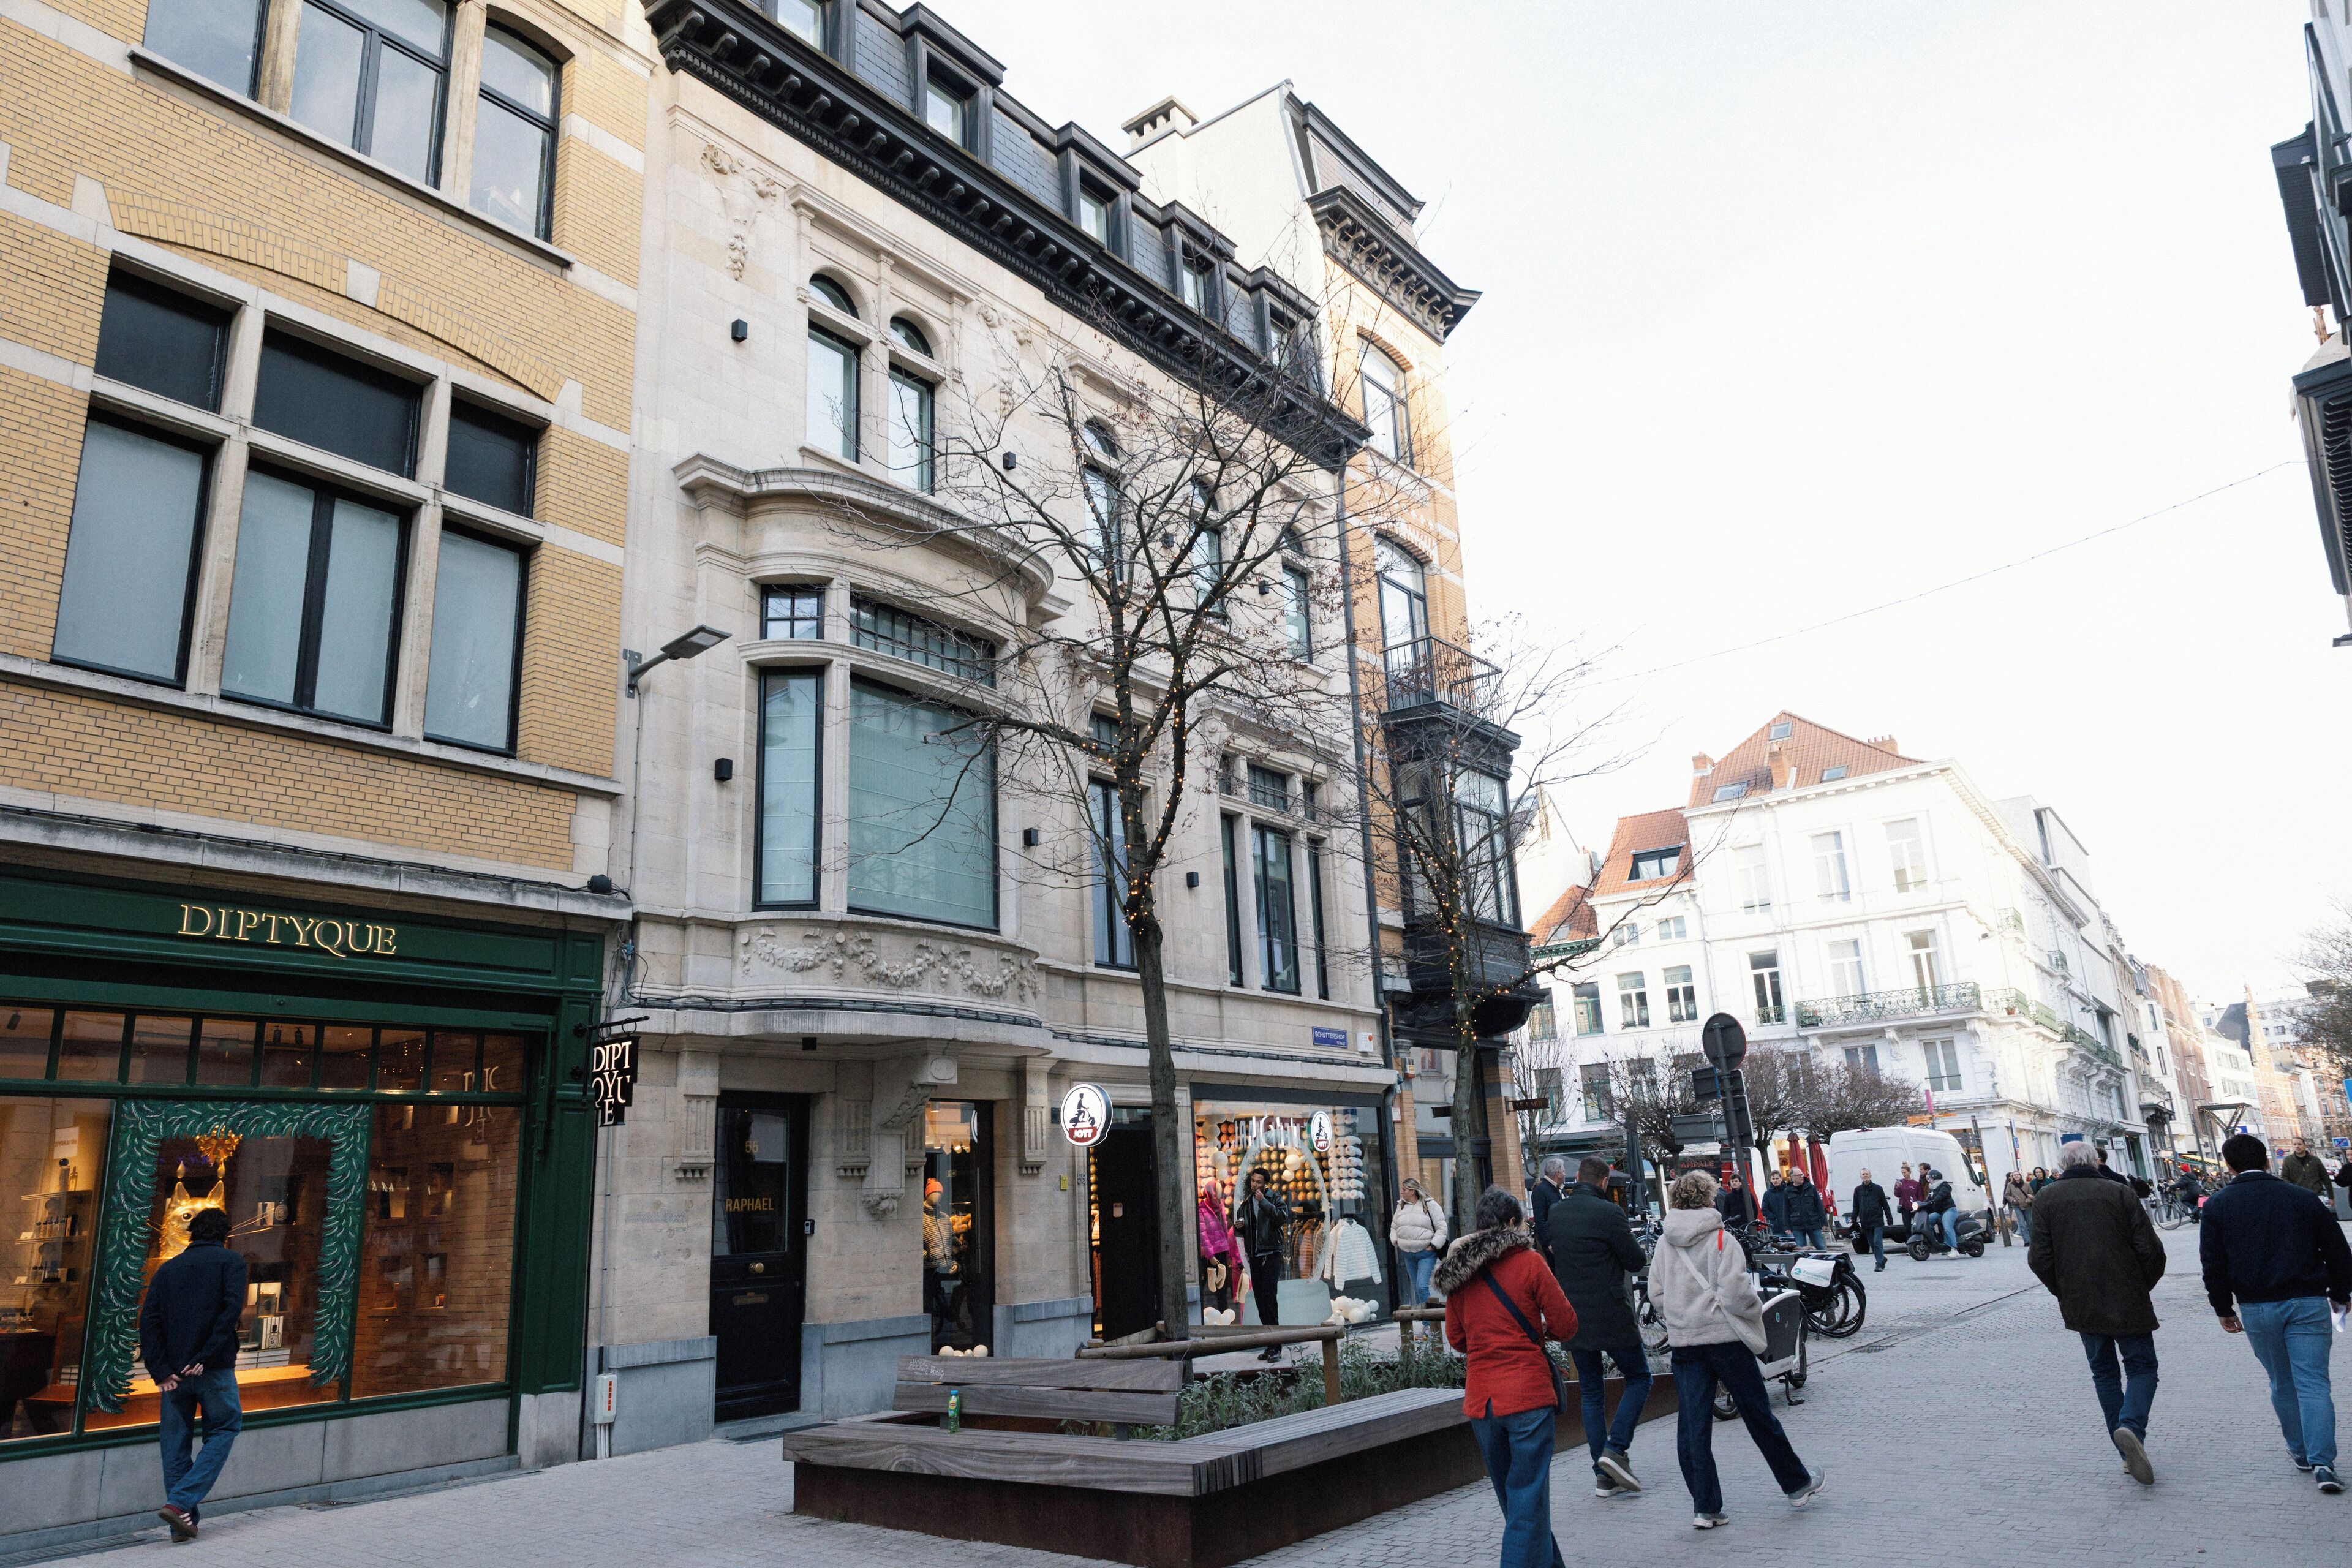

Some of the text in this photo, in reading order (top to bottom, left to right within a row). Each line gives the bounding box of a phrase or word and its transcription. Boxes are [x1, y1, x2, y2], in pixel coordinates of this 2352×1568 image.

[178, 904, 396, 957] DIPTYQUE
[1314, 1031, 1346, 1040] SCHUTTERSHOF
[592, 1041, 632, 1072] DIPT
[1073, 1128, 1093, 1139] JOTT
[745, 1140, 759, 1153] 55
[725, 1197, 774, 1212] RAPHAEL
